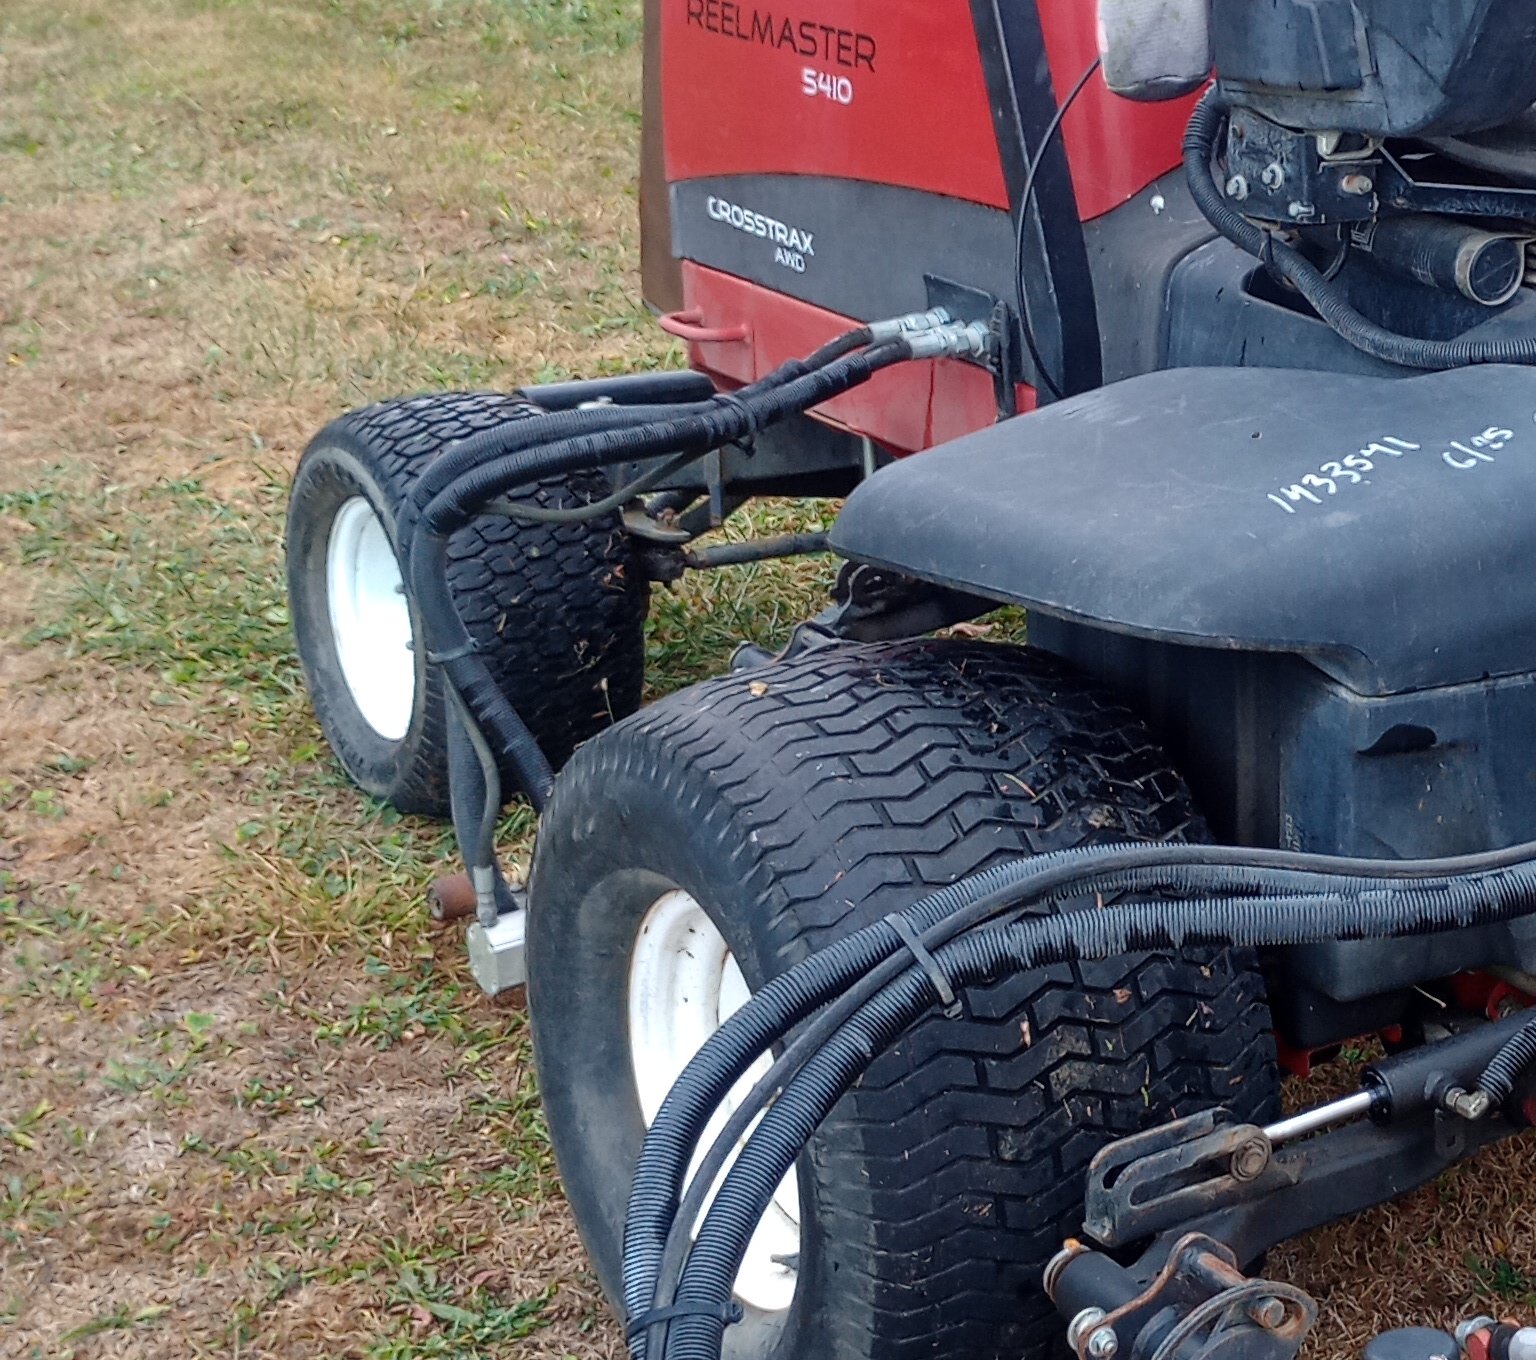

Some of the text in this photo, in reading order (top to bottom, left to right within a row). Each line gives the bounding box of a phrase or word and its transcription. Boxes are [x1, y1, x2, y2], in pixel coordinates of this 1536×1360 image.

[802, 67, 853, 105] 5410
[707, 195, 815, 256] CROSSTRAX
[774, 246, 807, 273] AWD
